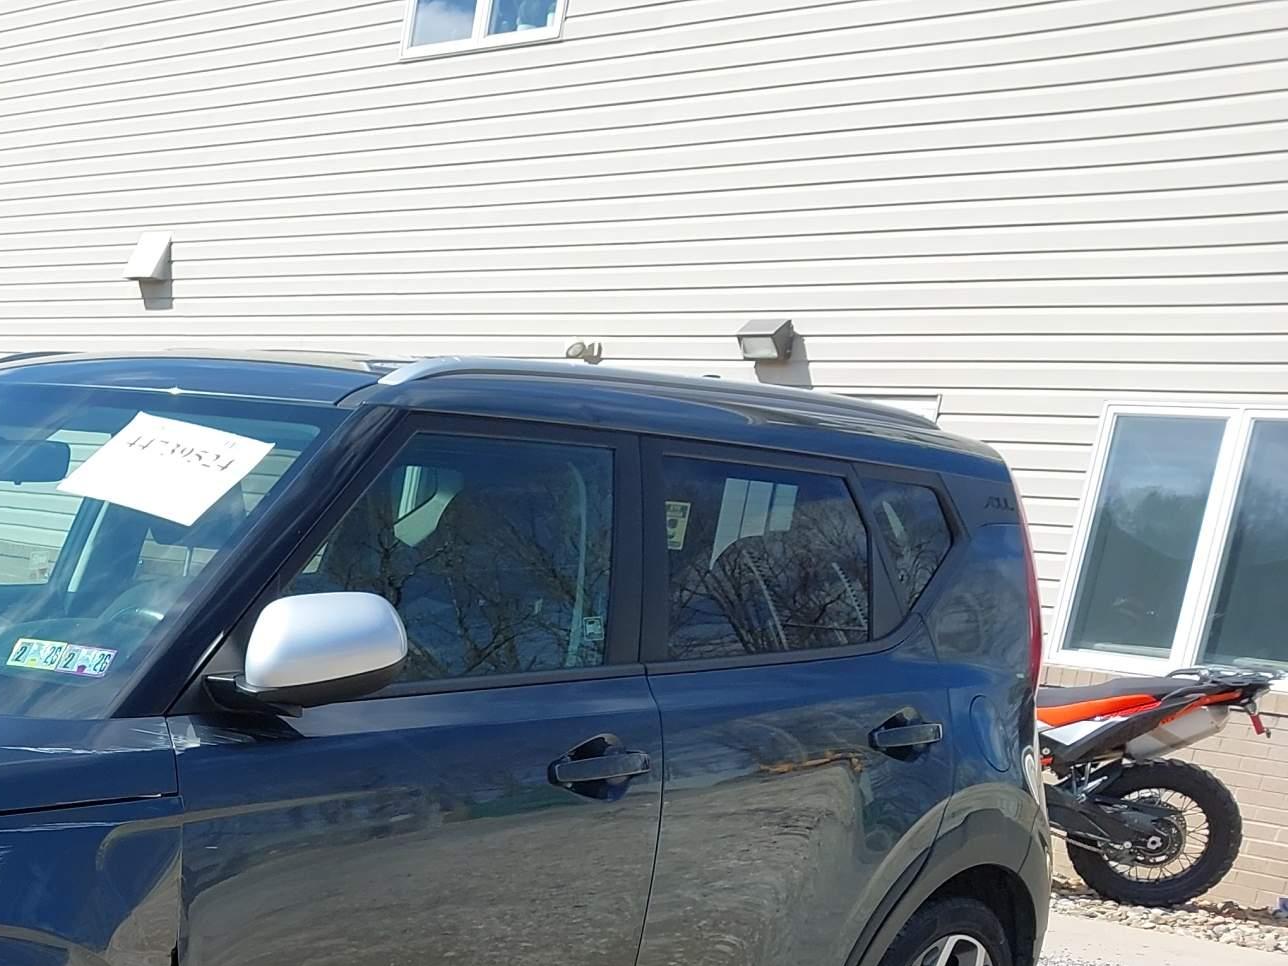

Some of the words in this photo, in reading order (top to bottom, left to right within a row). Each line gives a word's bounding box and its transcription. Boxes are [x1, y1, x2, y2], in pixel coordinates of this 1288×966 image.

[15, 646, 27, 661] 2
[63, 653, 75, 668] 2
[93, 653, 111, 673] 26
